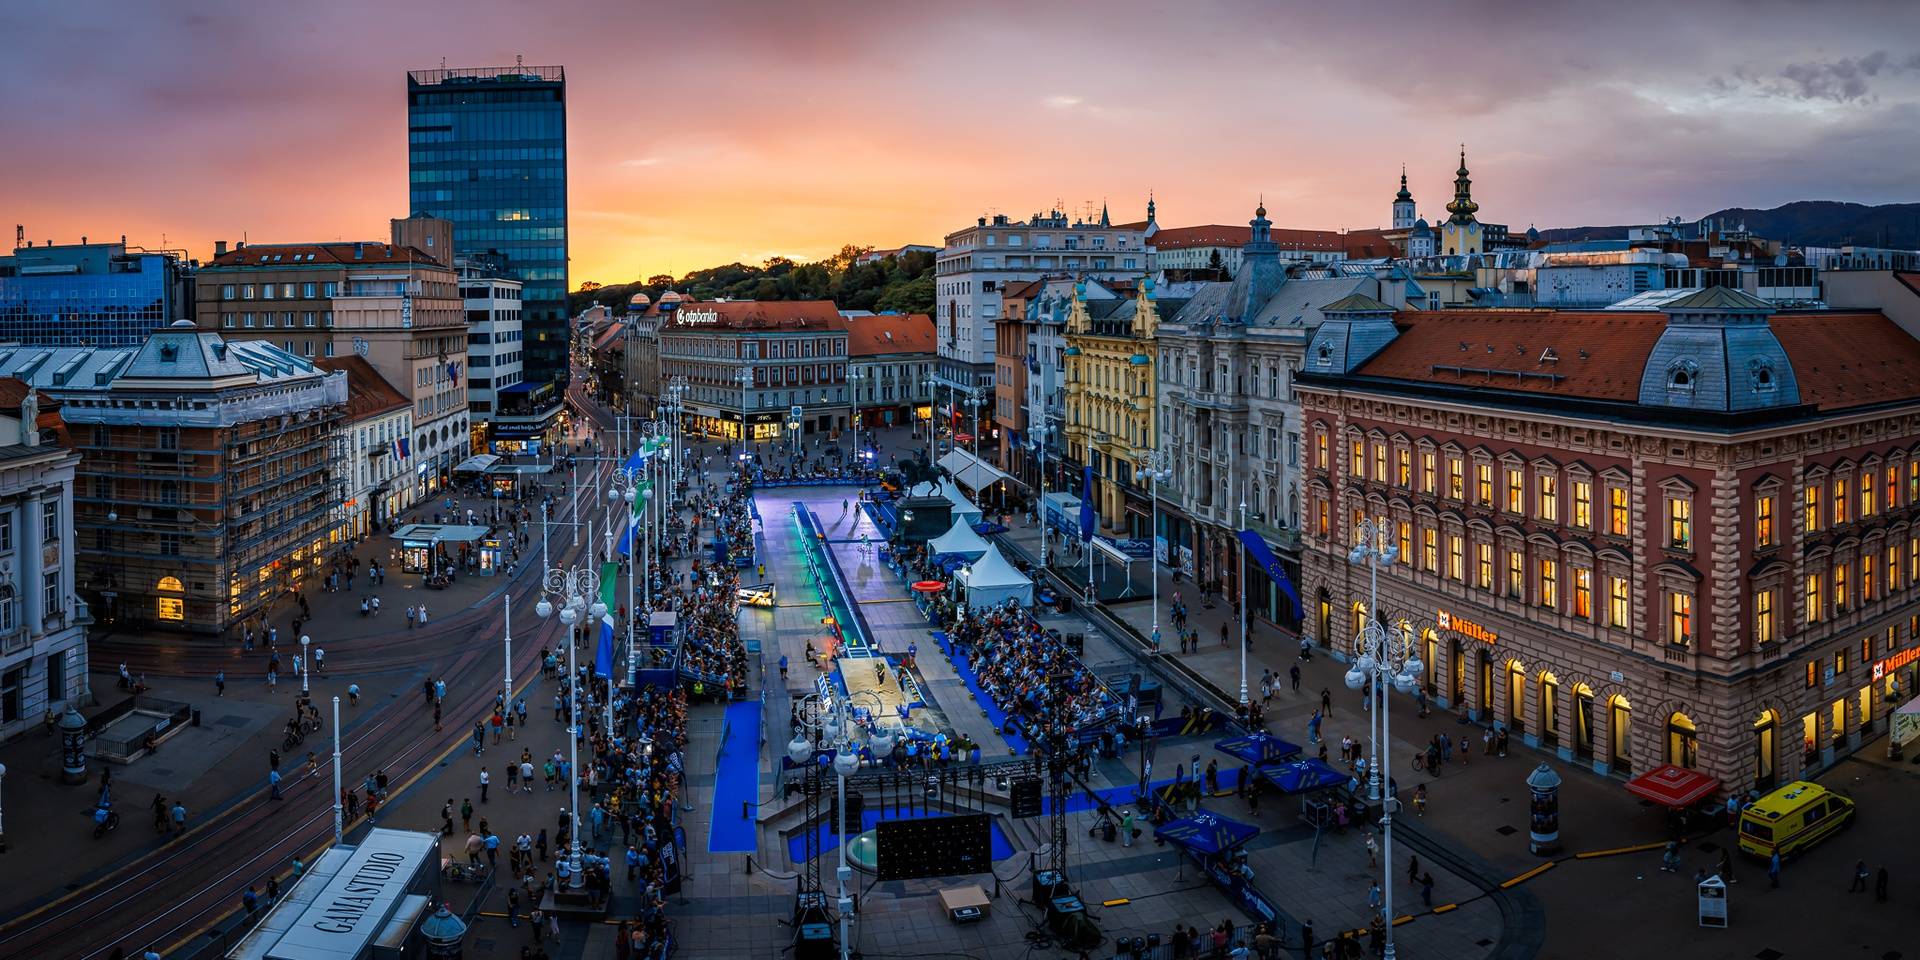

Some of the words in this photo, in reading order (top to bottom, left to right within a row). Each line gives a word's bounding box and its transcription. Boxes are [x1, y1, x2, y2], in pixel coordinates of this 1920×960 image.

[1451, 615, 1498, 645] Müller
[1885, 645, 1920, 675] Müller
[344, 852, 405, 895] STUDIO
[313, 896, 376, 934] GAMA
